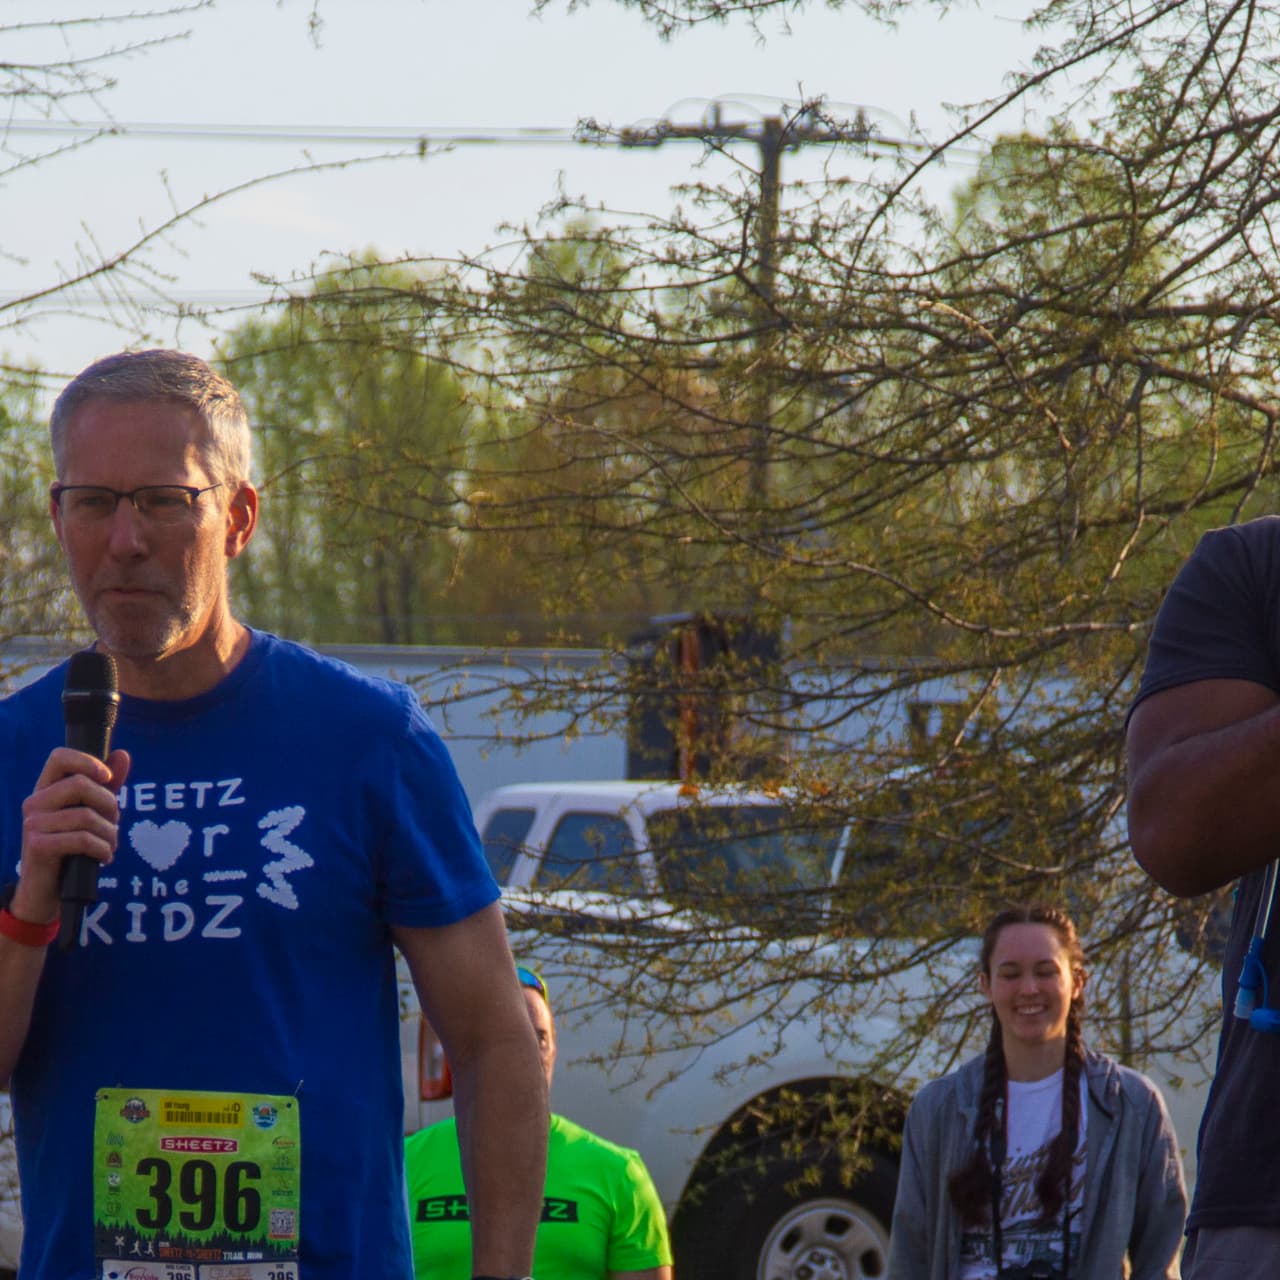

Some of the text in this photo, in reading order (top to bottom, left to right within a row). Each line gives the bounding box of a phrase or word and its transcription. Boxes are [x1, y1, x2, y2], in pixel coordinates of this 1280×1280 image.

[115, 778, 246, 811] HEETZ
[130, 875, 189, 897] the
[79, 895, 243, 947] KIDZ
[164, 1139, 234, 1152] SHEETZ
[135, 1157, 262, 1232] 396
[426, 1201, 568, 1218] SHZ
